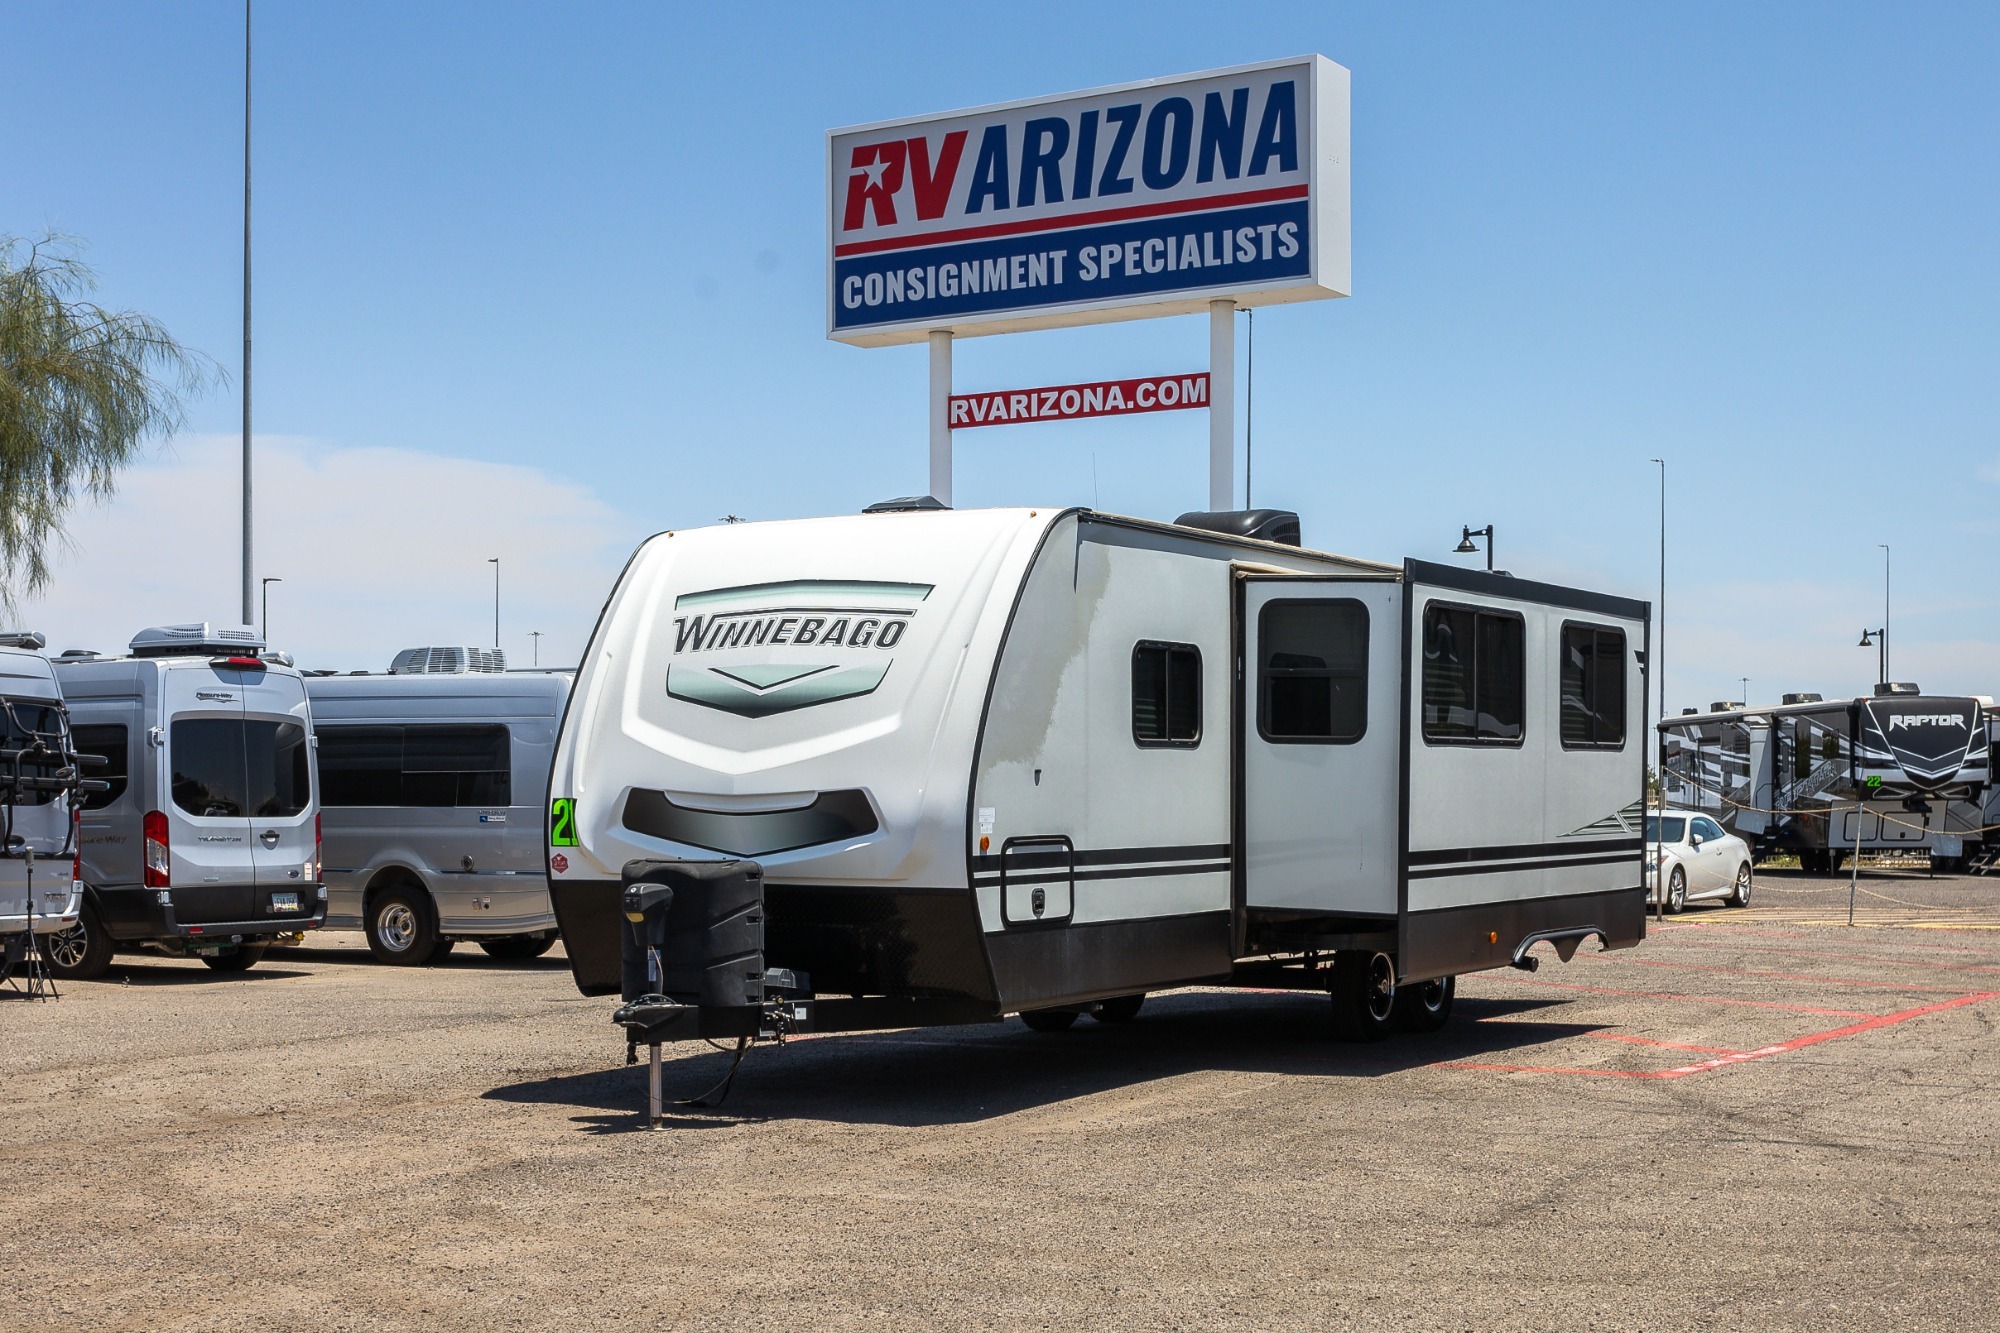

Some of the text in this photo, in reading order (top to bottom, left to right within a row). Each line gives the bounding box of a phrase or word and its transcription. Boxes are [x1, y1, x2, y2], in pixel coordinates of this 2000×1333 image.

[843, 222, 1299, 309] CONSIGNMENT SPECIALISTS
[950, 377, 1207, 424] RVARIZONA.COM
[673, 612, 909, 656] WINNEBAGO
[1889, 714, 1967, 732] RAPTOR
[1867, 776, 1881, 787] 22
